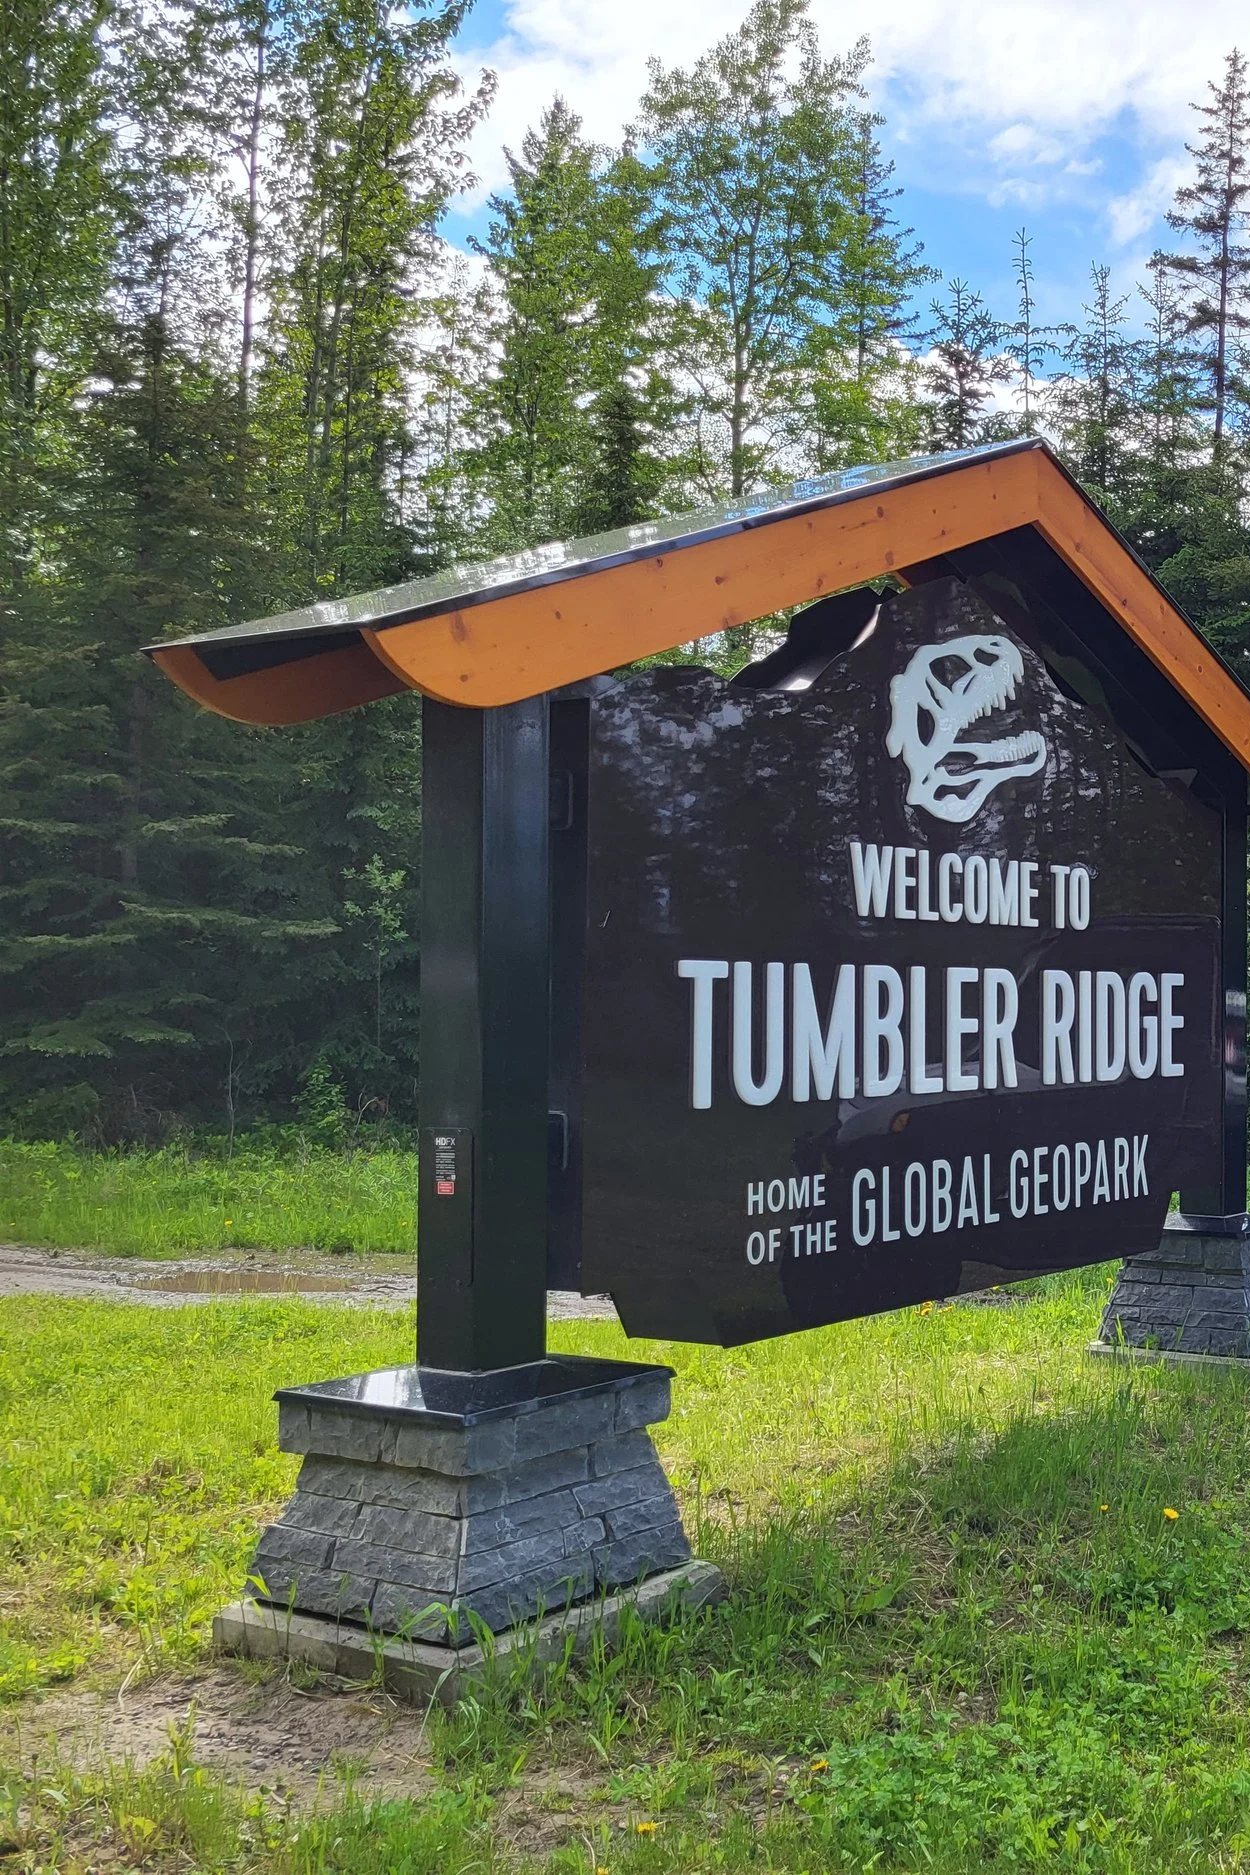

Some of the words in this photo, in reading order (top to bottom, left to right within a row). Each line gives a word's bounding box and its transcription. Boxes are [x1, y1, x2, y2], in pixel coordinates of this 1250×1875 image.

[849, 841, 1039, 928] WELCOME
[1050, 864, 1090, 931] TO
[677, 959, 1019, 1110] TUMBLER
[1043, 969, 1185, 1085] RIDGE
[435, 1137, 456, 1146] HDFX
[747, 1174, 826, 1216] HOME
[852, 1153, 1000, 1246] GLOBAL
[1010, 1134, 1149, 1219] GEOPARK
[746, 1228, 781, 1265] OF
[789, 1219, 837, 1258] THE
